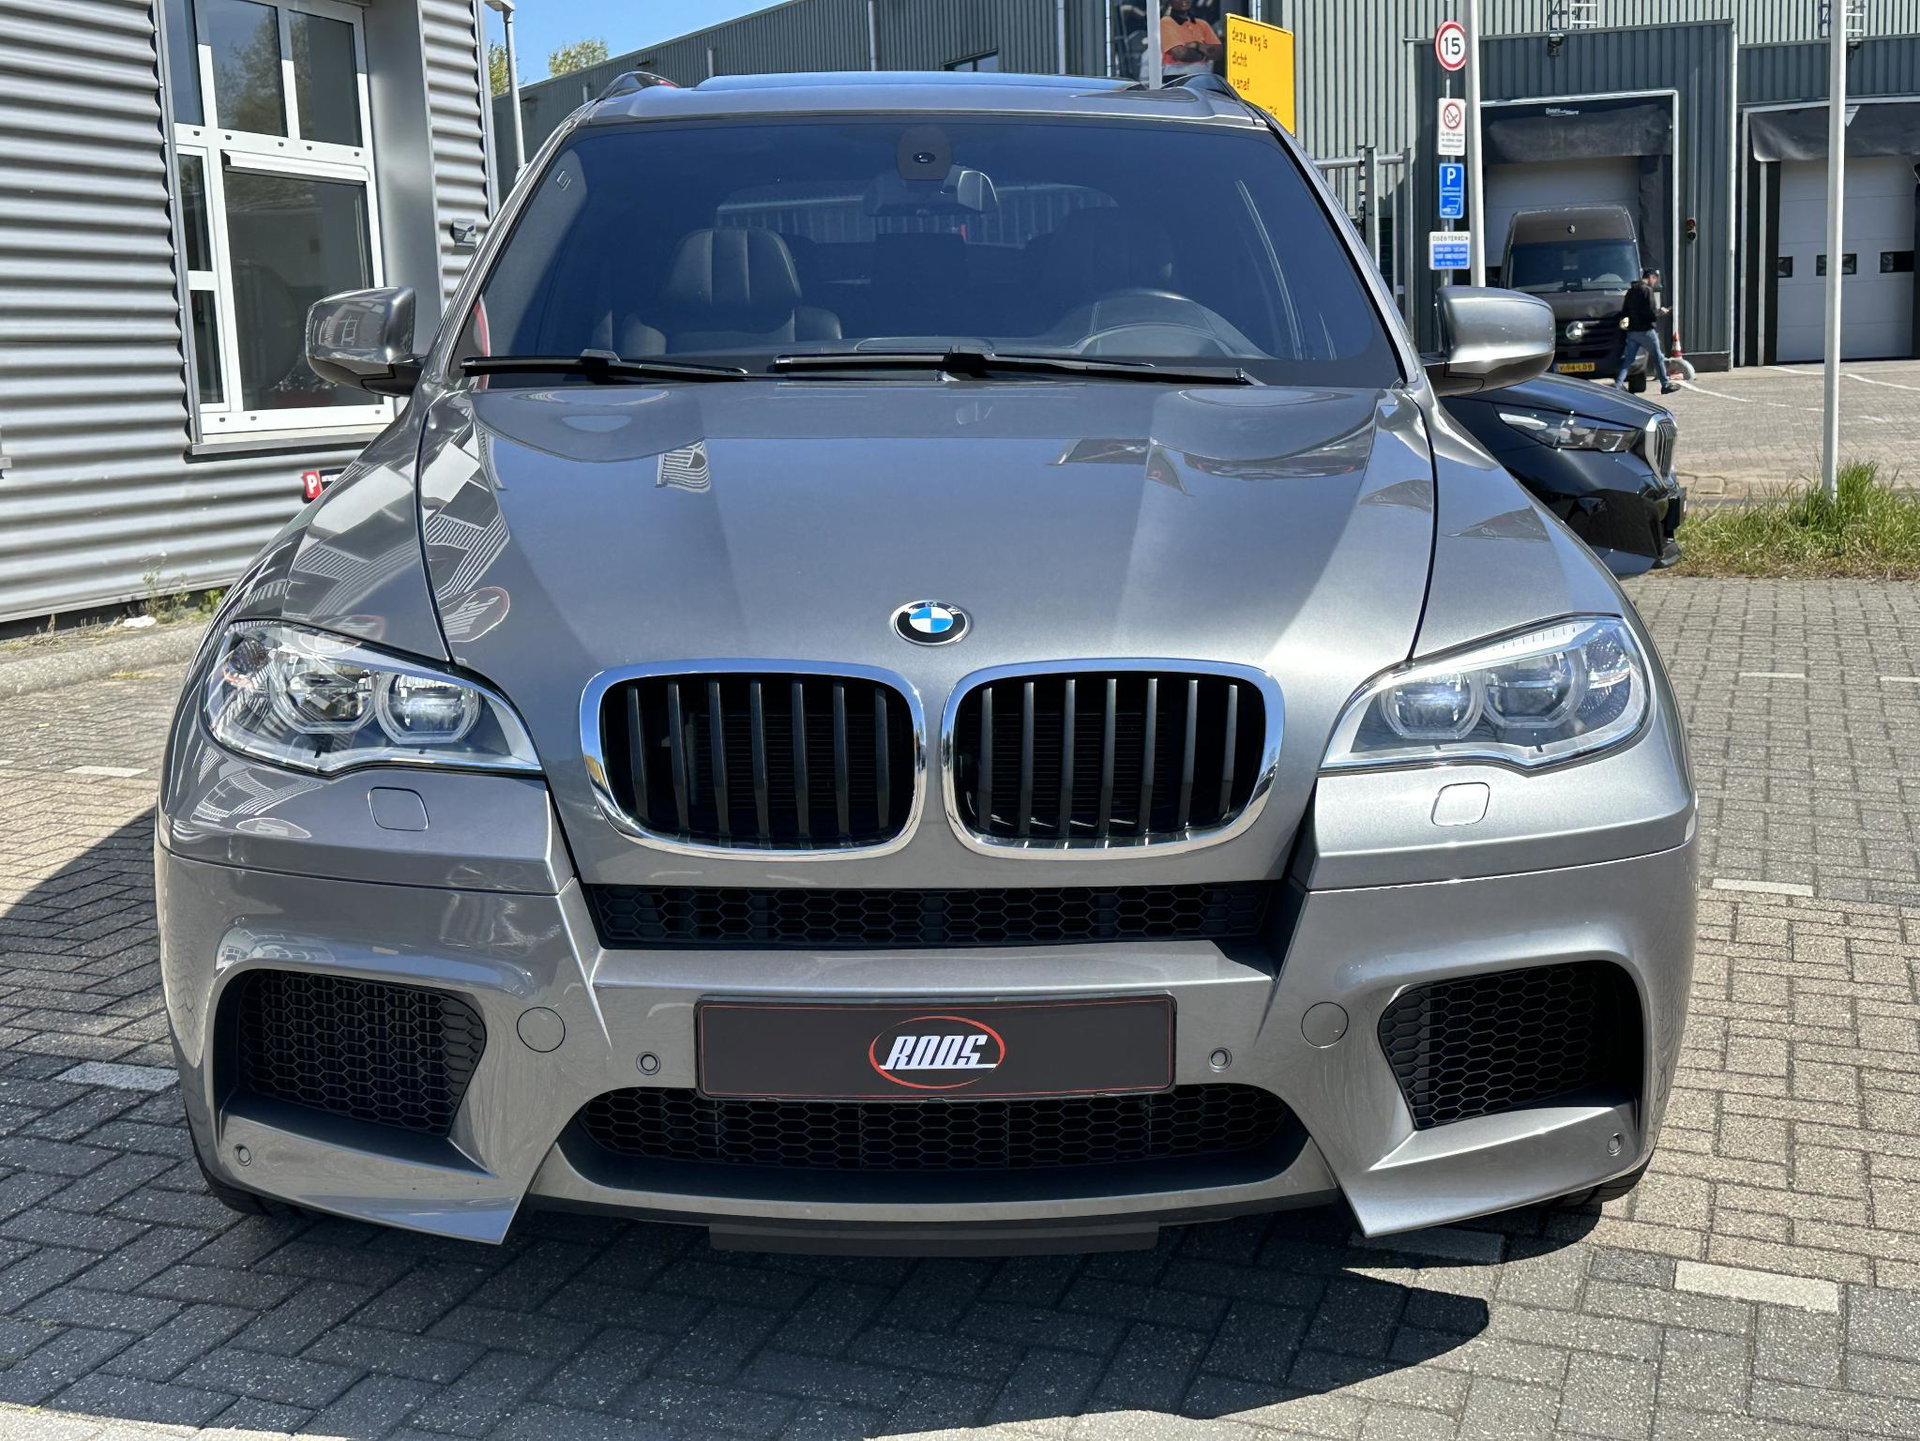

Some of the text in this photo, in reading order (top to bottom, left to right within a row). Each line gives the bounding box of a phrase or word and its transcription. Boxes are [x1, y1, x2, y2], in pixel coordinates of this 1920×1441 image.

[1444, 37, 1461, 55] 15
[1447, 167, 1456, 185] P
[306, 474, 318, 494] P
[883, 1034, 990, 1070] ROOS
